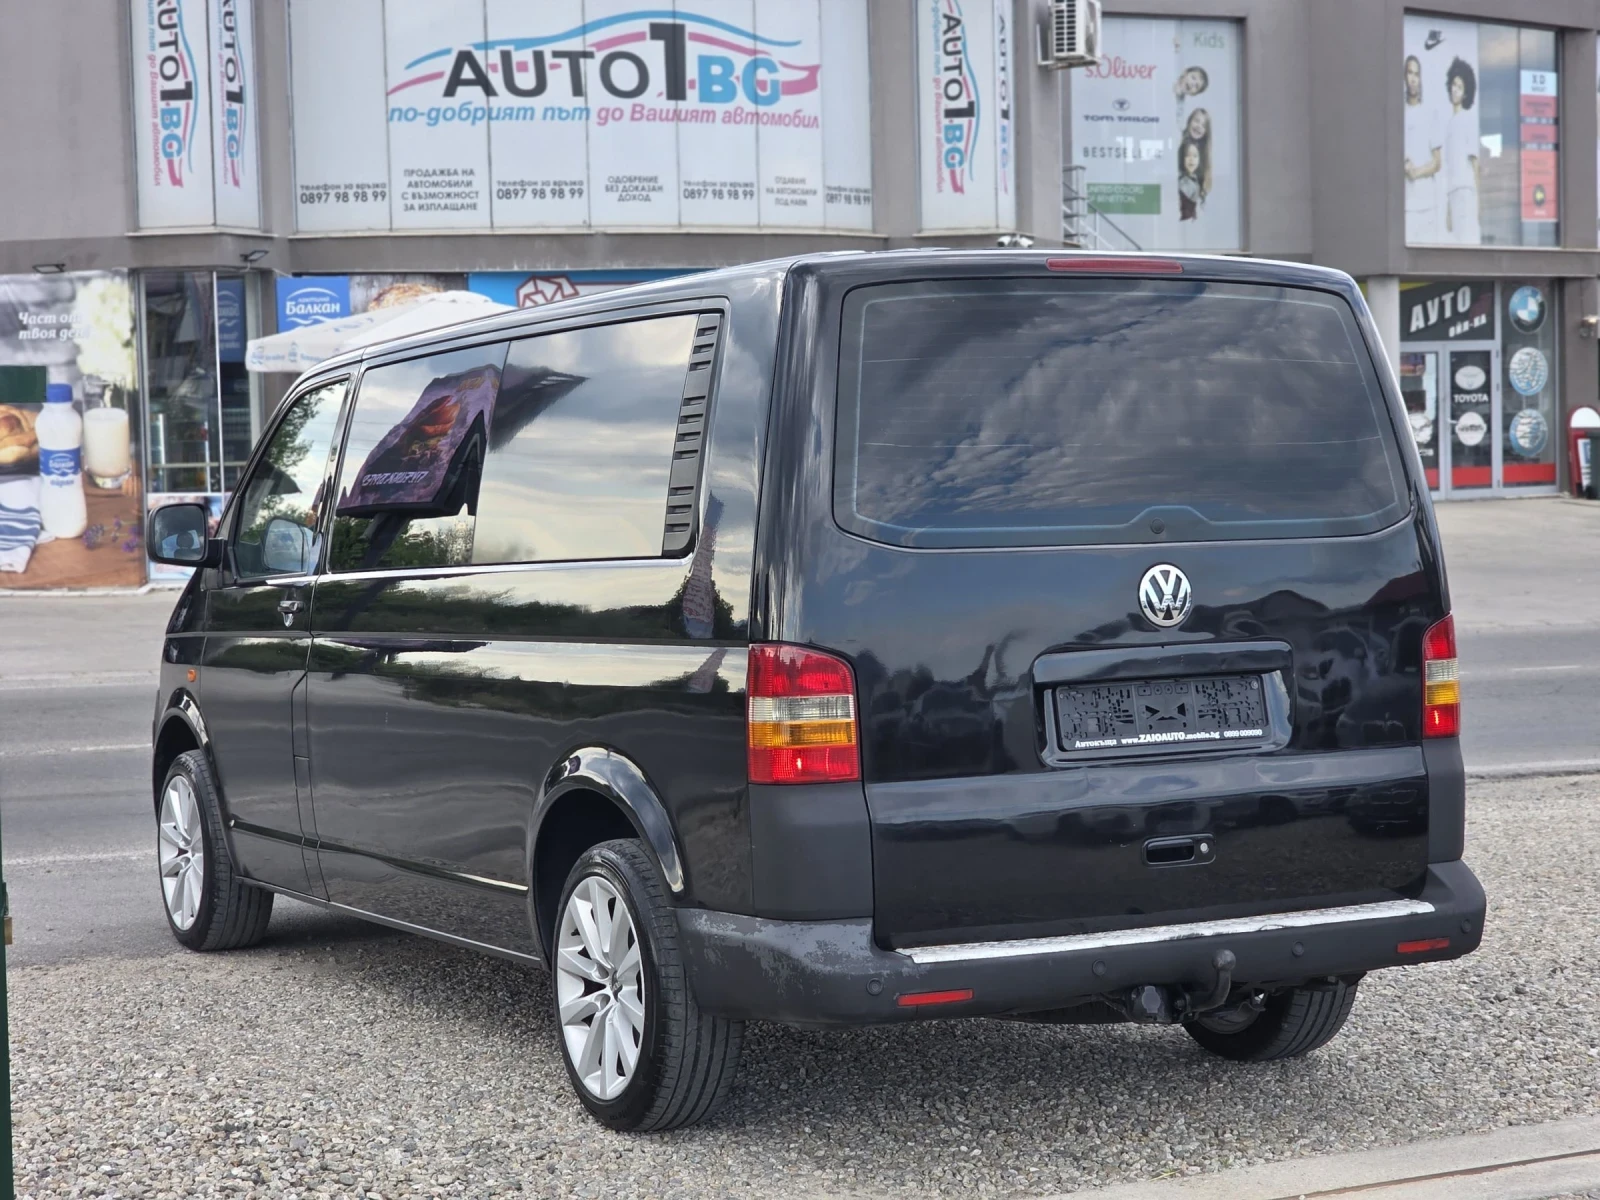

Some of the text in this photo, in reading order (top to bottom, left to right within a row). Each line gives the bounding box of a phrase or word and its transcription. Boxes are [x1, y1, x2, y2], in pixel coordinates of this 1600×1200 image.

[1194, 32, 1224, 48] Kids
[1085, 54, 1157, 79] s.Oliver
[157, 0, 193, 159] UTO1BG
[222, 0, 244, 158] UTO1BG
[388, 101, 820, 129] по-добрият път до Вашият автомобил
[1117, 115, 1160, 123] TAILOR
[403, 168, 475, 177] ПРОДАЖБА НА
[407, 180, 473, 188] АВТОМОБИЛИ
[607, 175, 658, 184] ОДОБРЕНИЕ
[300, 183, 341, 192] телефон
[605, 184, 663, 193] БЕЗ ДОКАЗАН
[300, 190, 387, 204] 0897 98 98 99
[401, 191, 479, 200] С ВЪЗМОЖНОСТ
[497, 188, 584, 200] 0897 98 98 99
[617, 193, 652, 202] ДОХОД
[683, 188, 754, 200] 0897 98 98 99
[404, 203, 477, 212] ЗА ИЗПЛАЩАНЕ
[285, 301, 340, 315] Балкан
[1409, 286, 1471, 333] АУТО
[18, 312, 56, 325] Част
[18, 327, 56, 341] твоя
[1454, 394, 1488, 403] TOYOTA
[1075, 738, 1117, 749] Автокъща
